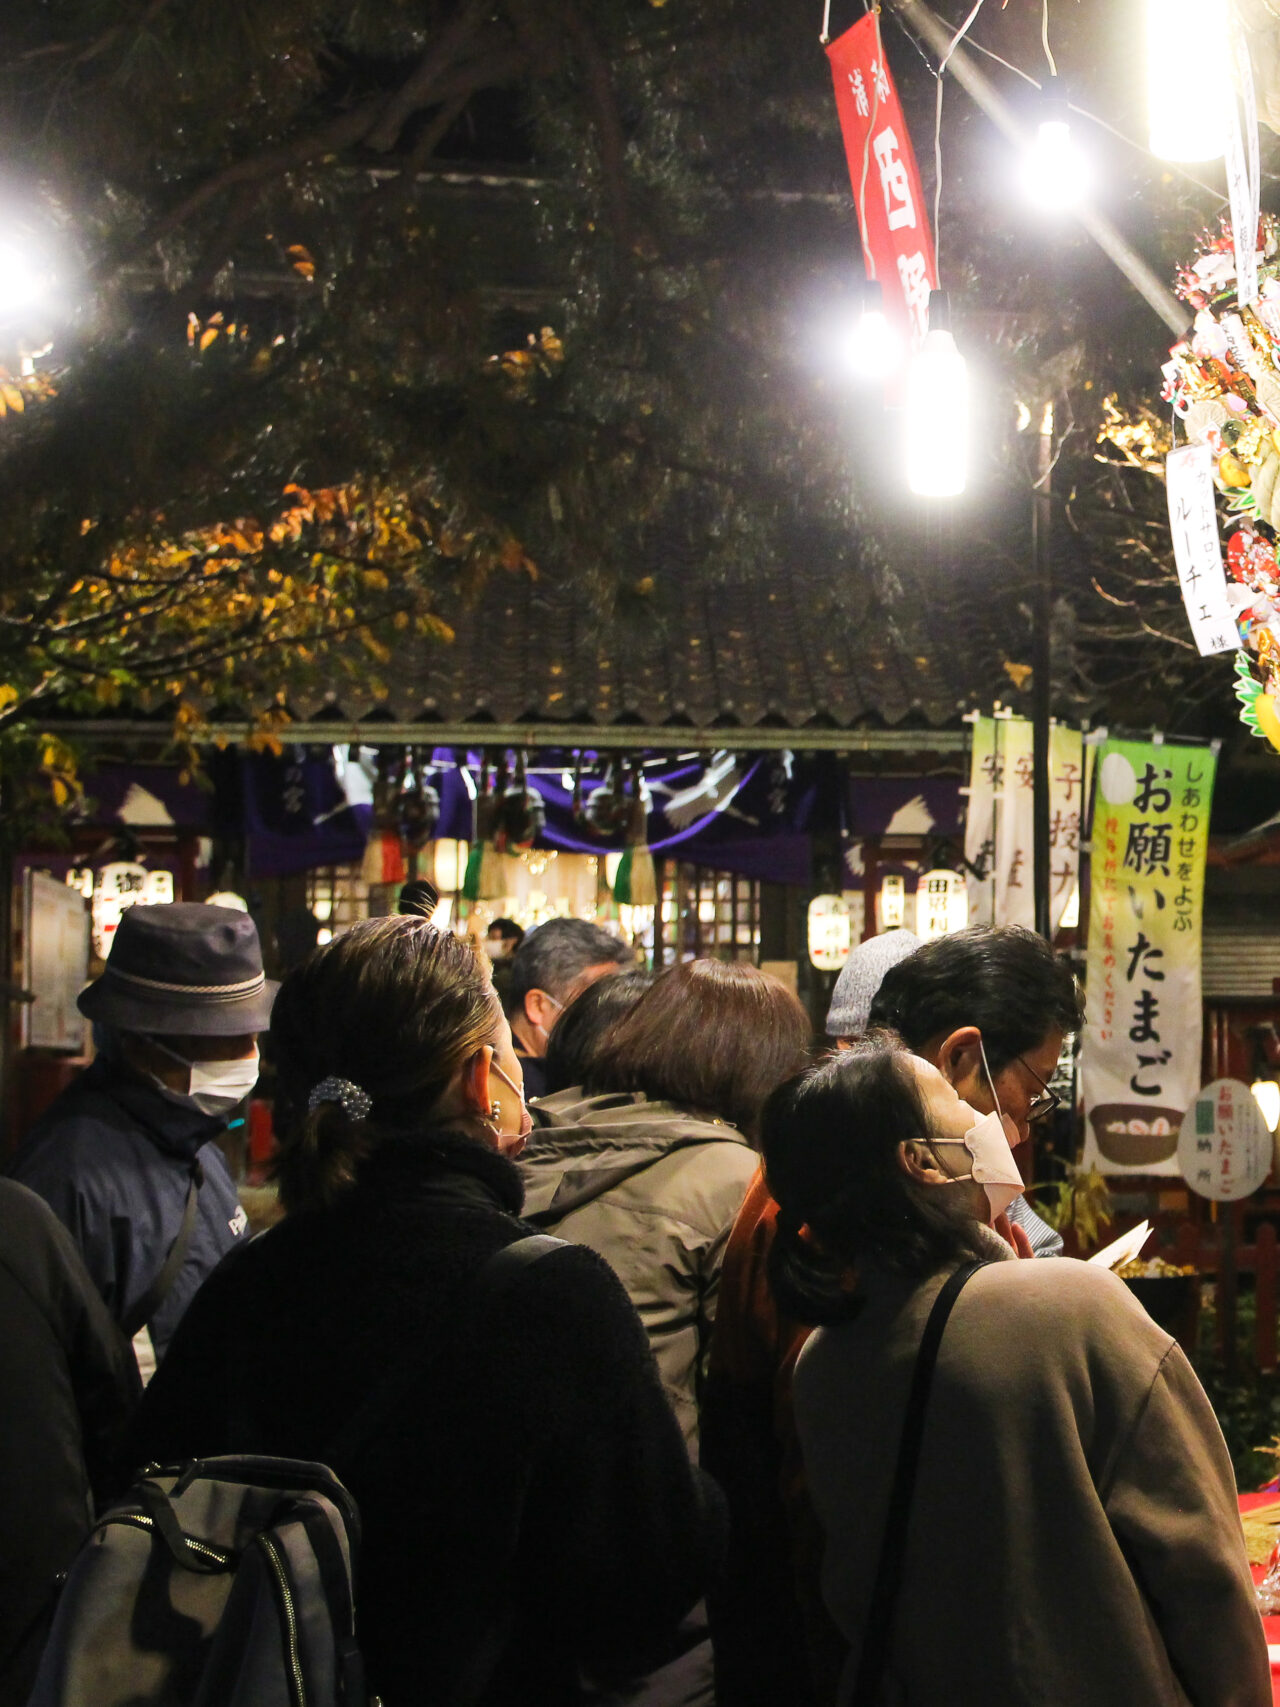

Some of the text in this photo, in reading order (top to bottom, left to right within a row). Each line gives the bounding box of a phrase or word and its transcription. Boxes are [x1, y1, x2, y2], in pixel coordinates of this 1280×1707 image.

[1123, 762, 1173, 1097] お願いたまご
[1173, 761, 1203, 932] しあわせをよぶ
